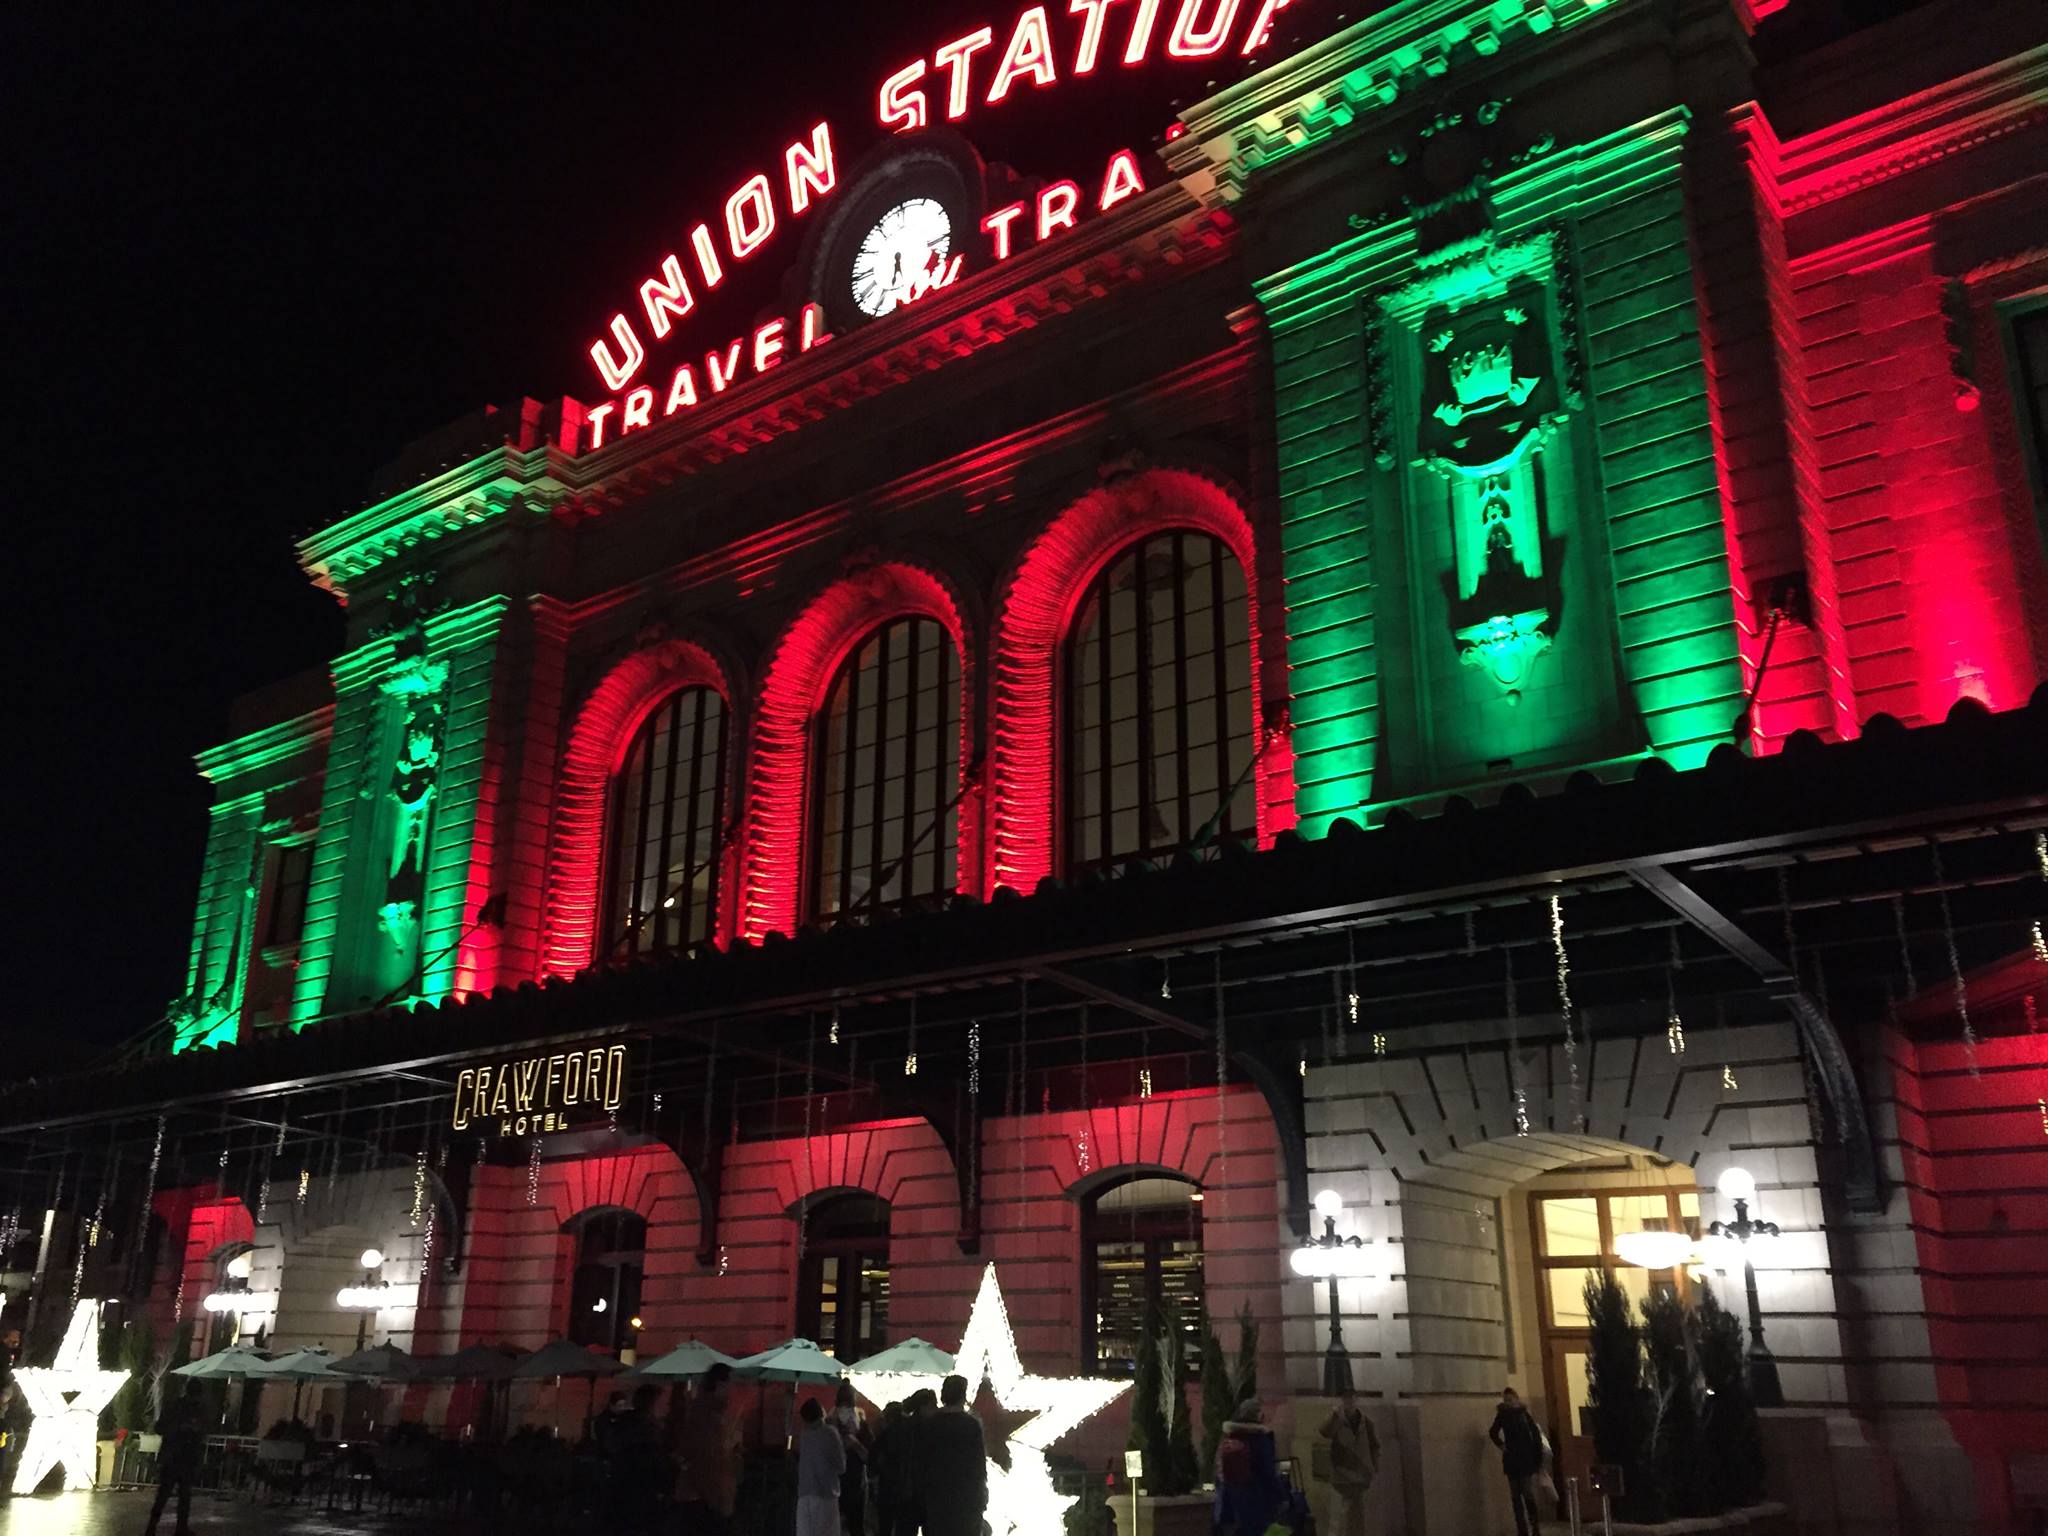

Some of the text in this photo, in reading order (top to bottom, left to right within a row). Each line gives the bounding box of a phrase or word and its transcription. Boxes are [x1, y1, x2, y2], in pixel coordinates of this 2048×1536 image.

[587, 121, 1185, 450] TRAVEL TRA
[589, 120, 836, 391] UNION
[452, 1044, 627, 1131] CRAWFORD
[500, 1111, 569, 1137] HOTEL
